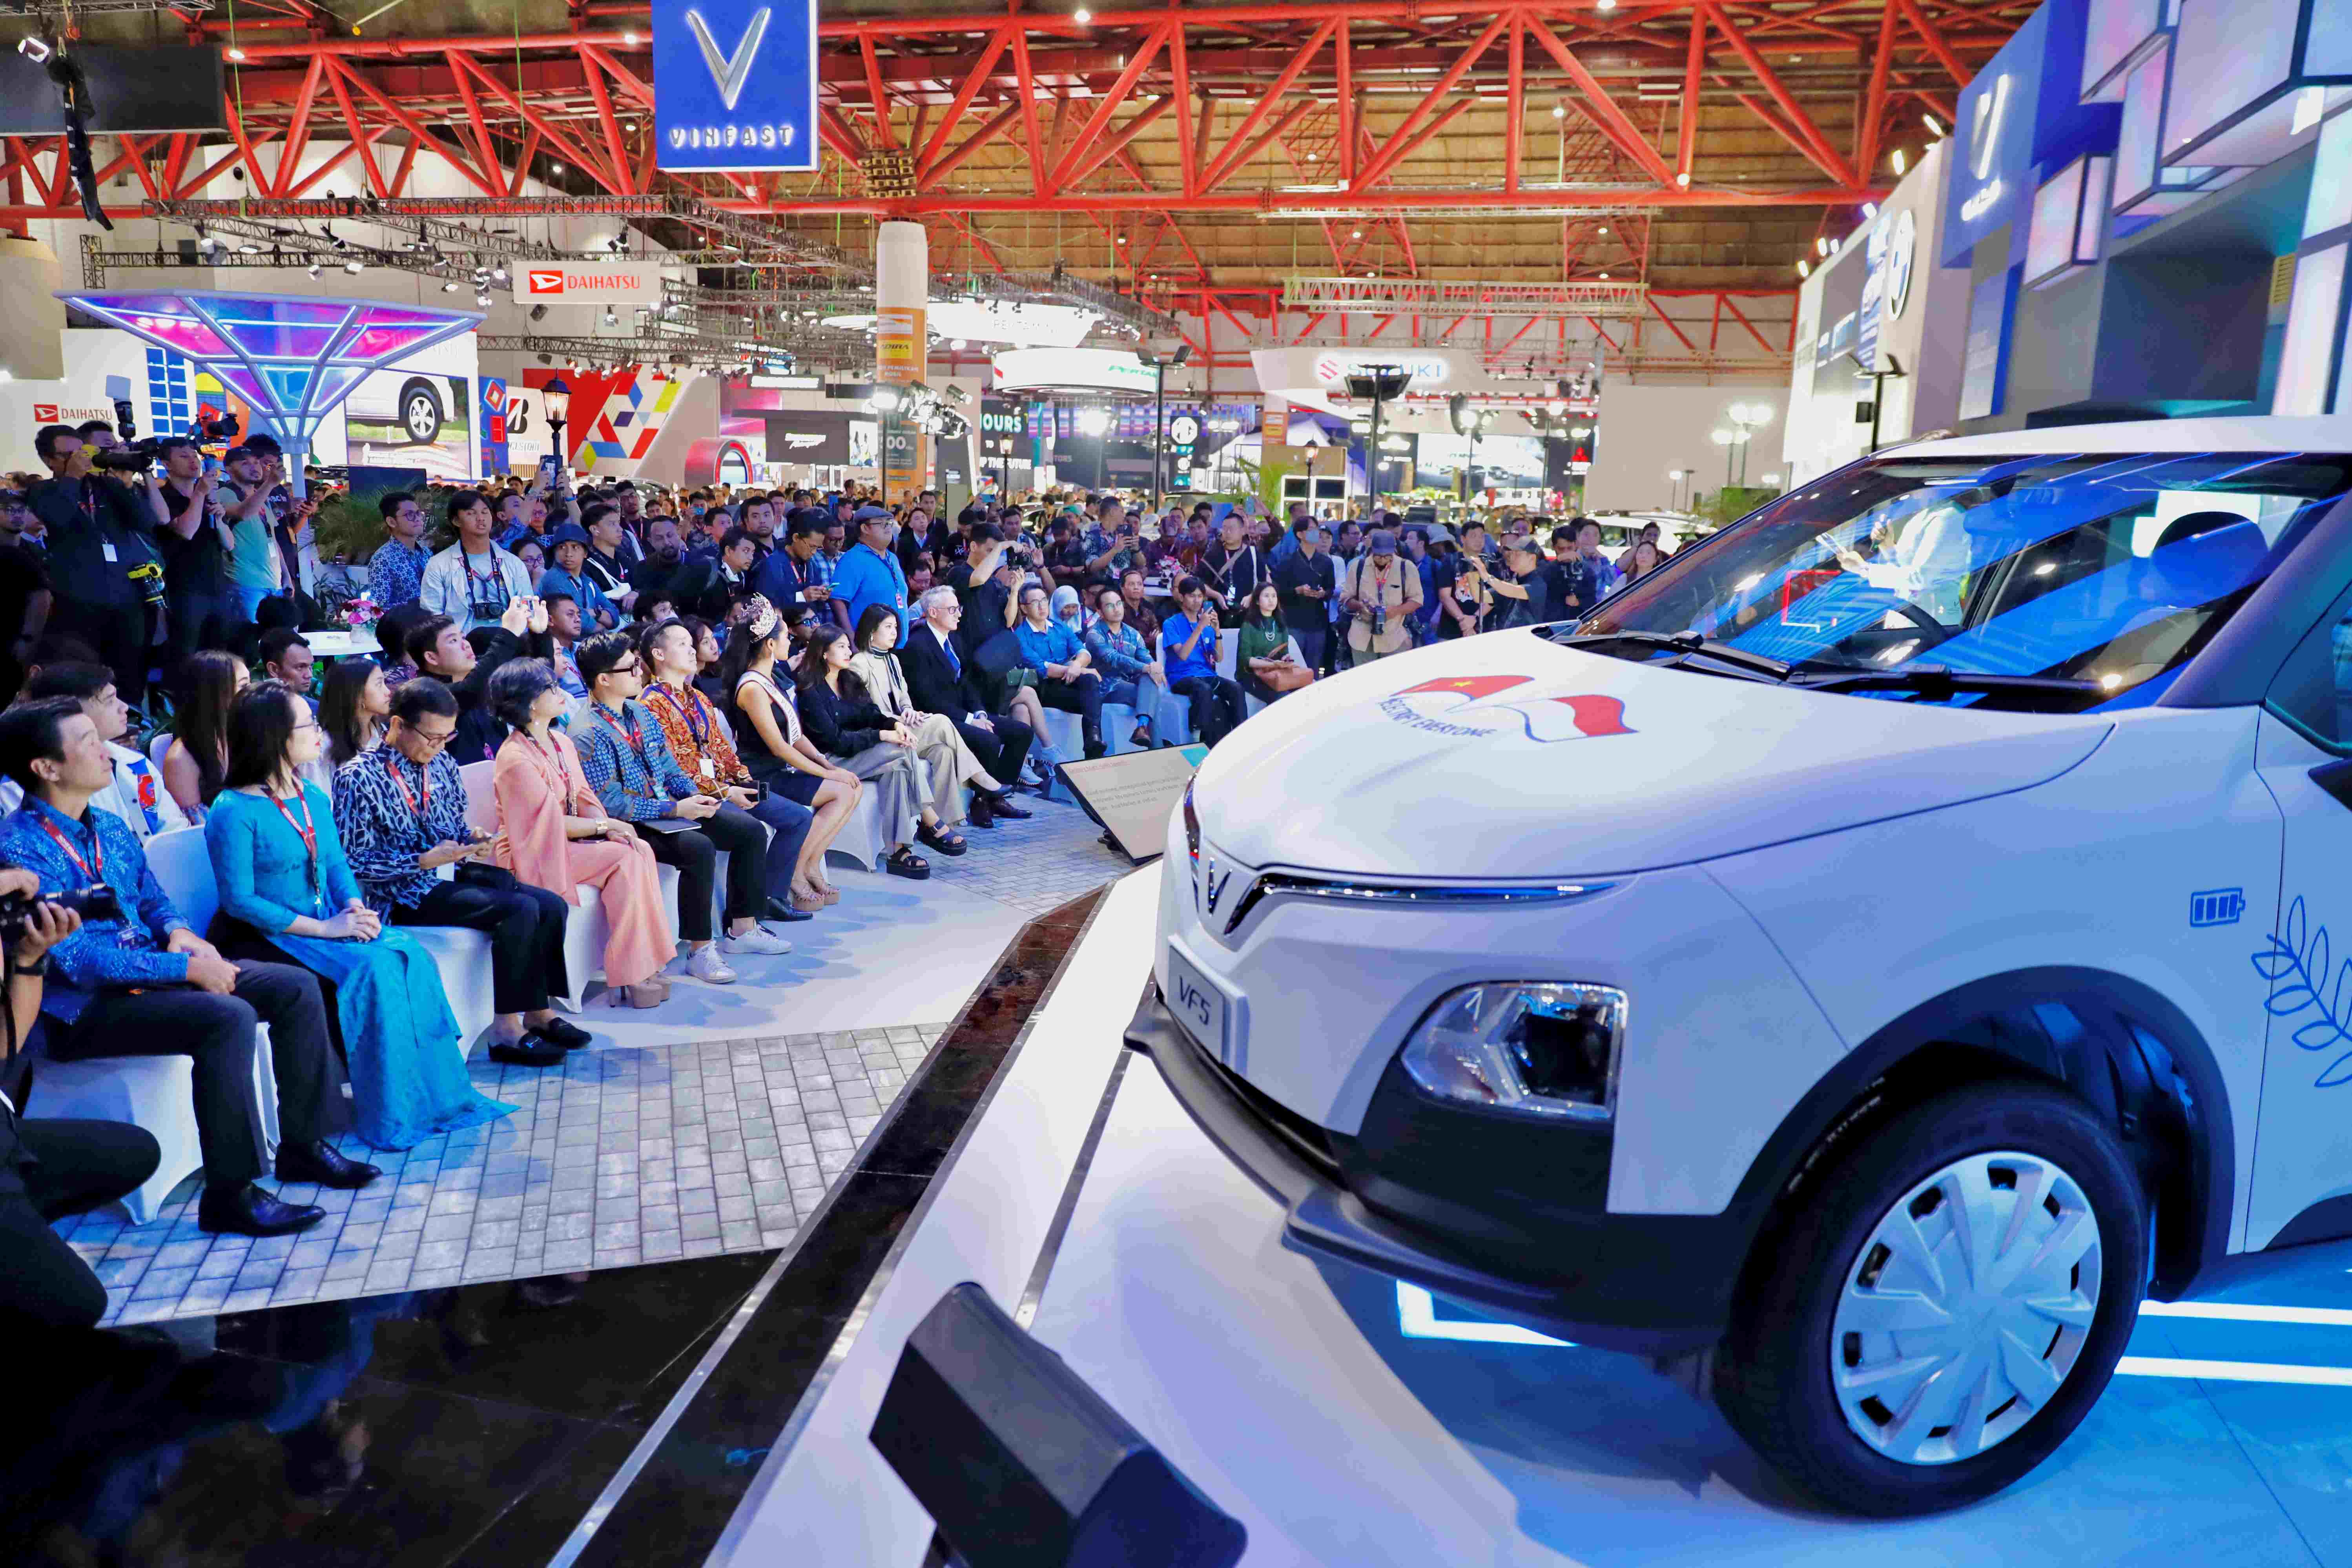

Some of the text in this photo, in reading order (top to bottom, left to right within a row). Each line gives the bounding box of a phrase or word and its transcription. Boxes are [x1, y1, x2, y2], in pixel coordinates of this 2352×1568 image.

[669, 123, 794, 149] VINFAST
[567, 275, 640, 289] DAIHATSU
[61, 408, 113, 421] DAIHATSU
